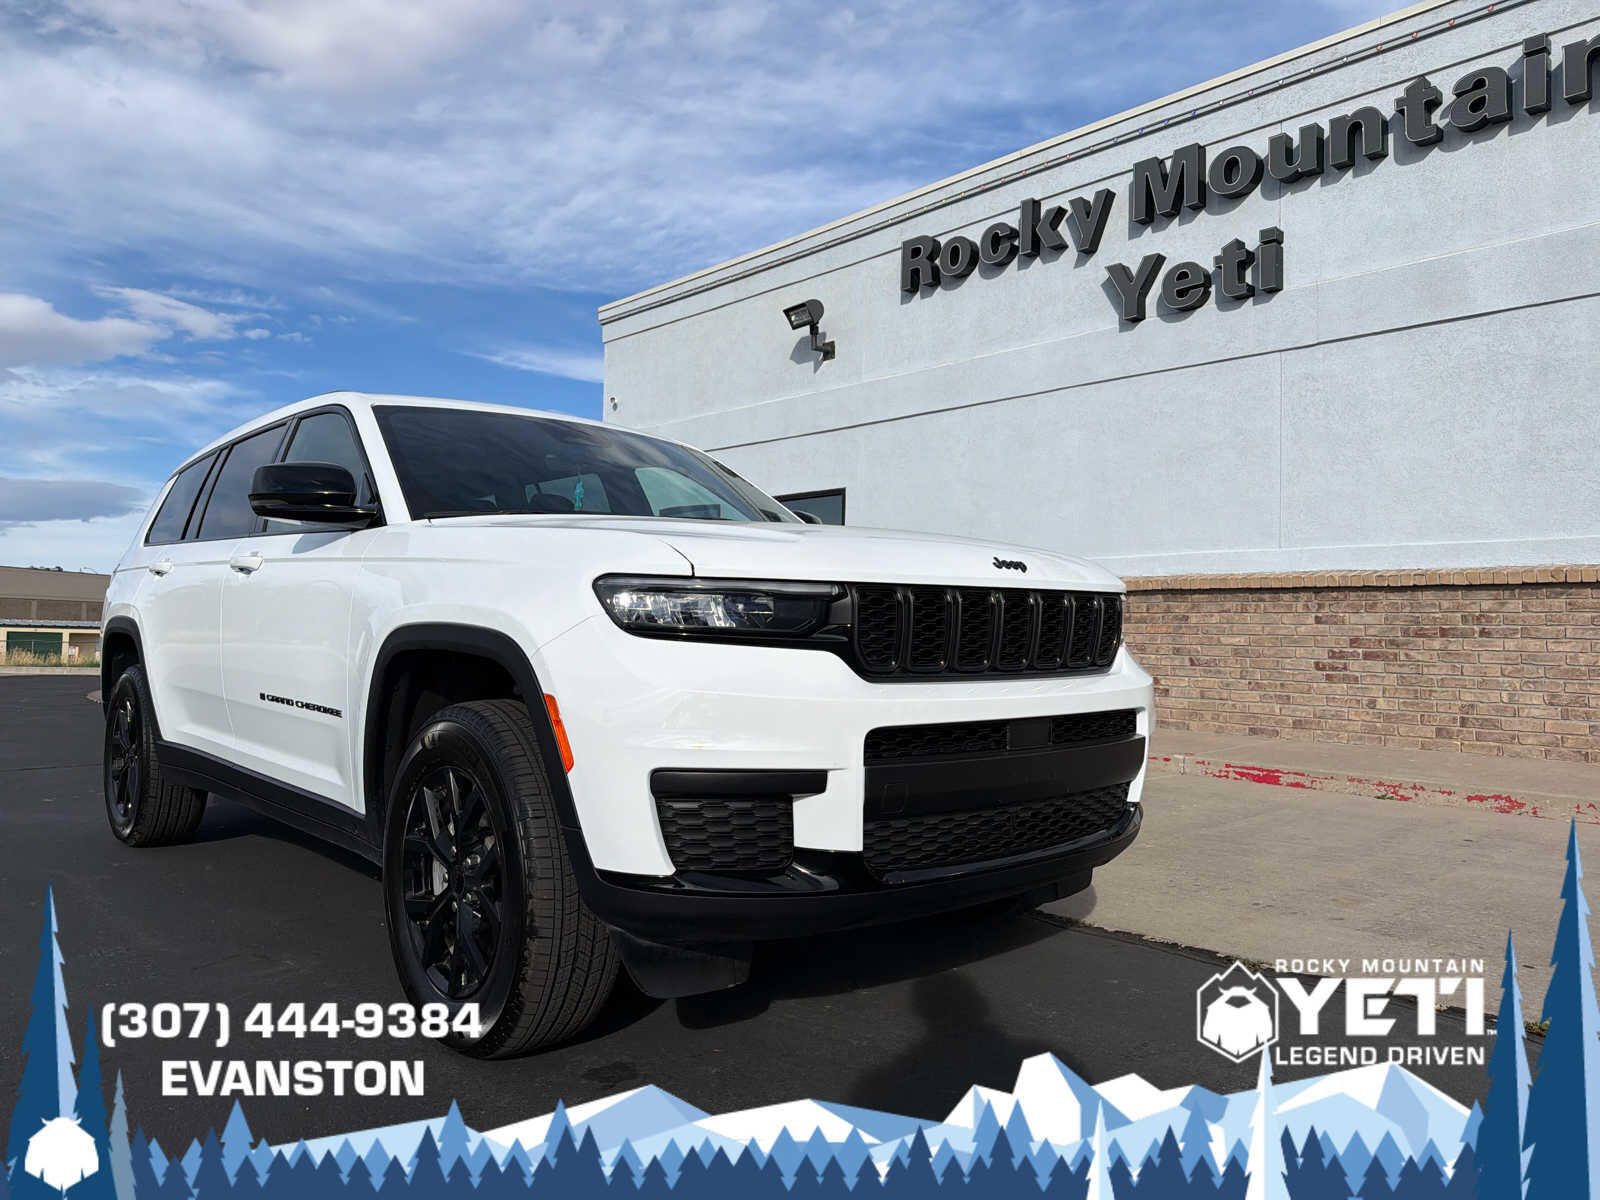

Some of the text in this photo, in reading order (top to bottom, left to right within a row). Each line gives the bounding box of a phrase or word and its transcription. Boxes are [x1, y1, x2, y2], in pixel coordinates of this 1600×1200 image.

[900, 187, 1116, 293] Rocky
[1105, 226, 1284, 323] Yeti
[993, 556, 1028, 573] Jeep
[266, 694, 343, 718] GRAND CHEROKEE
